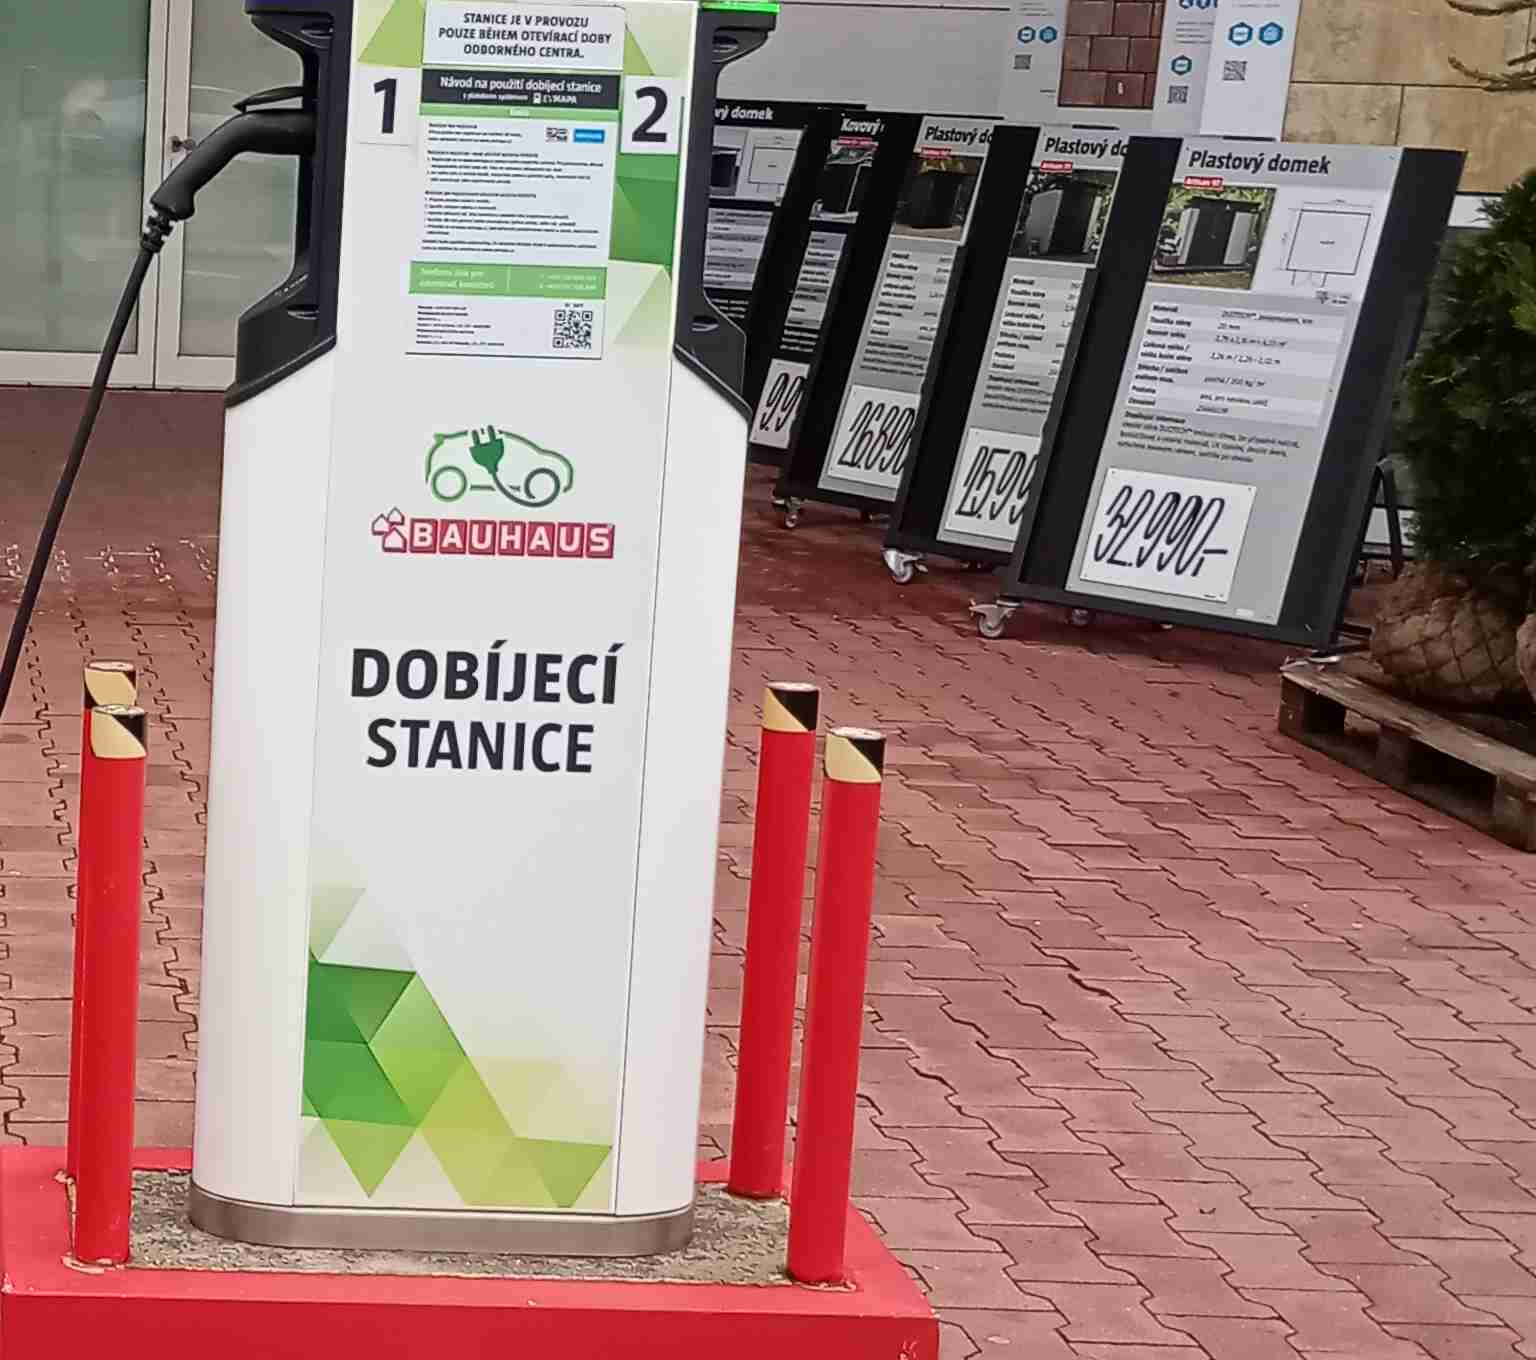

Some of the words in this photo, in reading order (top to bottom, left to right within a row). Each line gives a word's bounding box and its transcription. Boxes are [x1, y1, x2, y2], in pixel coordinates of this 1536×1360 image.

[464, 12, 507, 25] STANICE
[510, 14, 521, 25] JE
[524, 15, 533, 26] V
[535, 16, 589, 28] PROVOZU
[439, 27, 476, 39] POUZE
[479, 26, 518, 41] BĚHEM
[521, 29, 579, 43] OTEVÍRACÍ
[581, 33, 612, 44] DOBY
[464, 43, 536, 57] ODBORNÉHO
[440, 76, 473, 88] Návod
[475, 79, 487, 88] na
[374, 78, 396, 133] 1
[631, 86, 667, 142] 2
[924, 126, 978, 146] Plastový
[1044, 137, 1107, 158] Plastový
[1188, 150, 1265, 175] Plastový
[1267, 153, 1331, 175] domek
[411, 520, 614, 557] BAUHAUS
[350, 640, 625, 705] DOBÍJECÍ
[365, 717, 595, 773] STANICE
